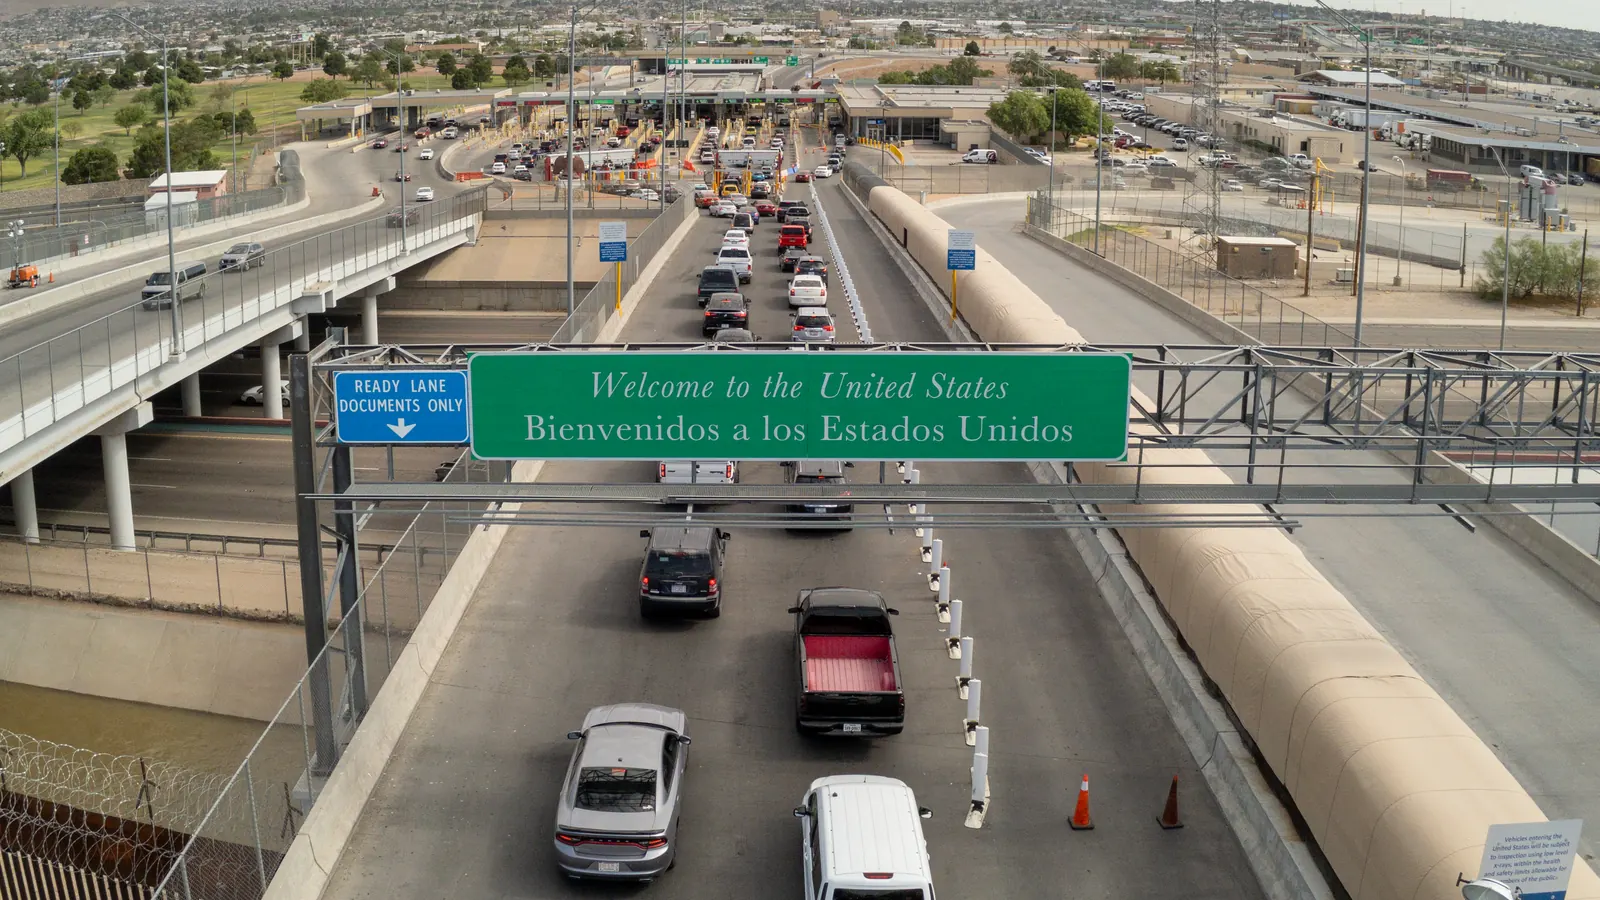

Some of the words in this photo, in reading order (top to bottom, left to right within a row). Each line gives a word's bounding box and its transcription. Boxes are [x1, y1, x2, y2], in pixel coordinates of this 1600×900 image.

[355, 379, 400, 393] READY
[411, 379, 446, 393] LANE
[591, 371, 714, 398] Welcome
[726, 375, 750, 398] to
[763, 371, 803, 398] the
[820, 372, 917, 399] United
[926, 372, 1009, 399] States
[340, 398, 420, 413] DOCUMENTS
[428, 398, 463, 412] ONLY
[524, 414, 720, 441] Bienvenidos
[732, 423, 750, 441] a
[762, 415, 806, 441] los
[820, 415, 945, 442] Estados
[958, 415, 1073, 442] Unidos
